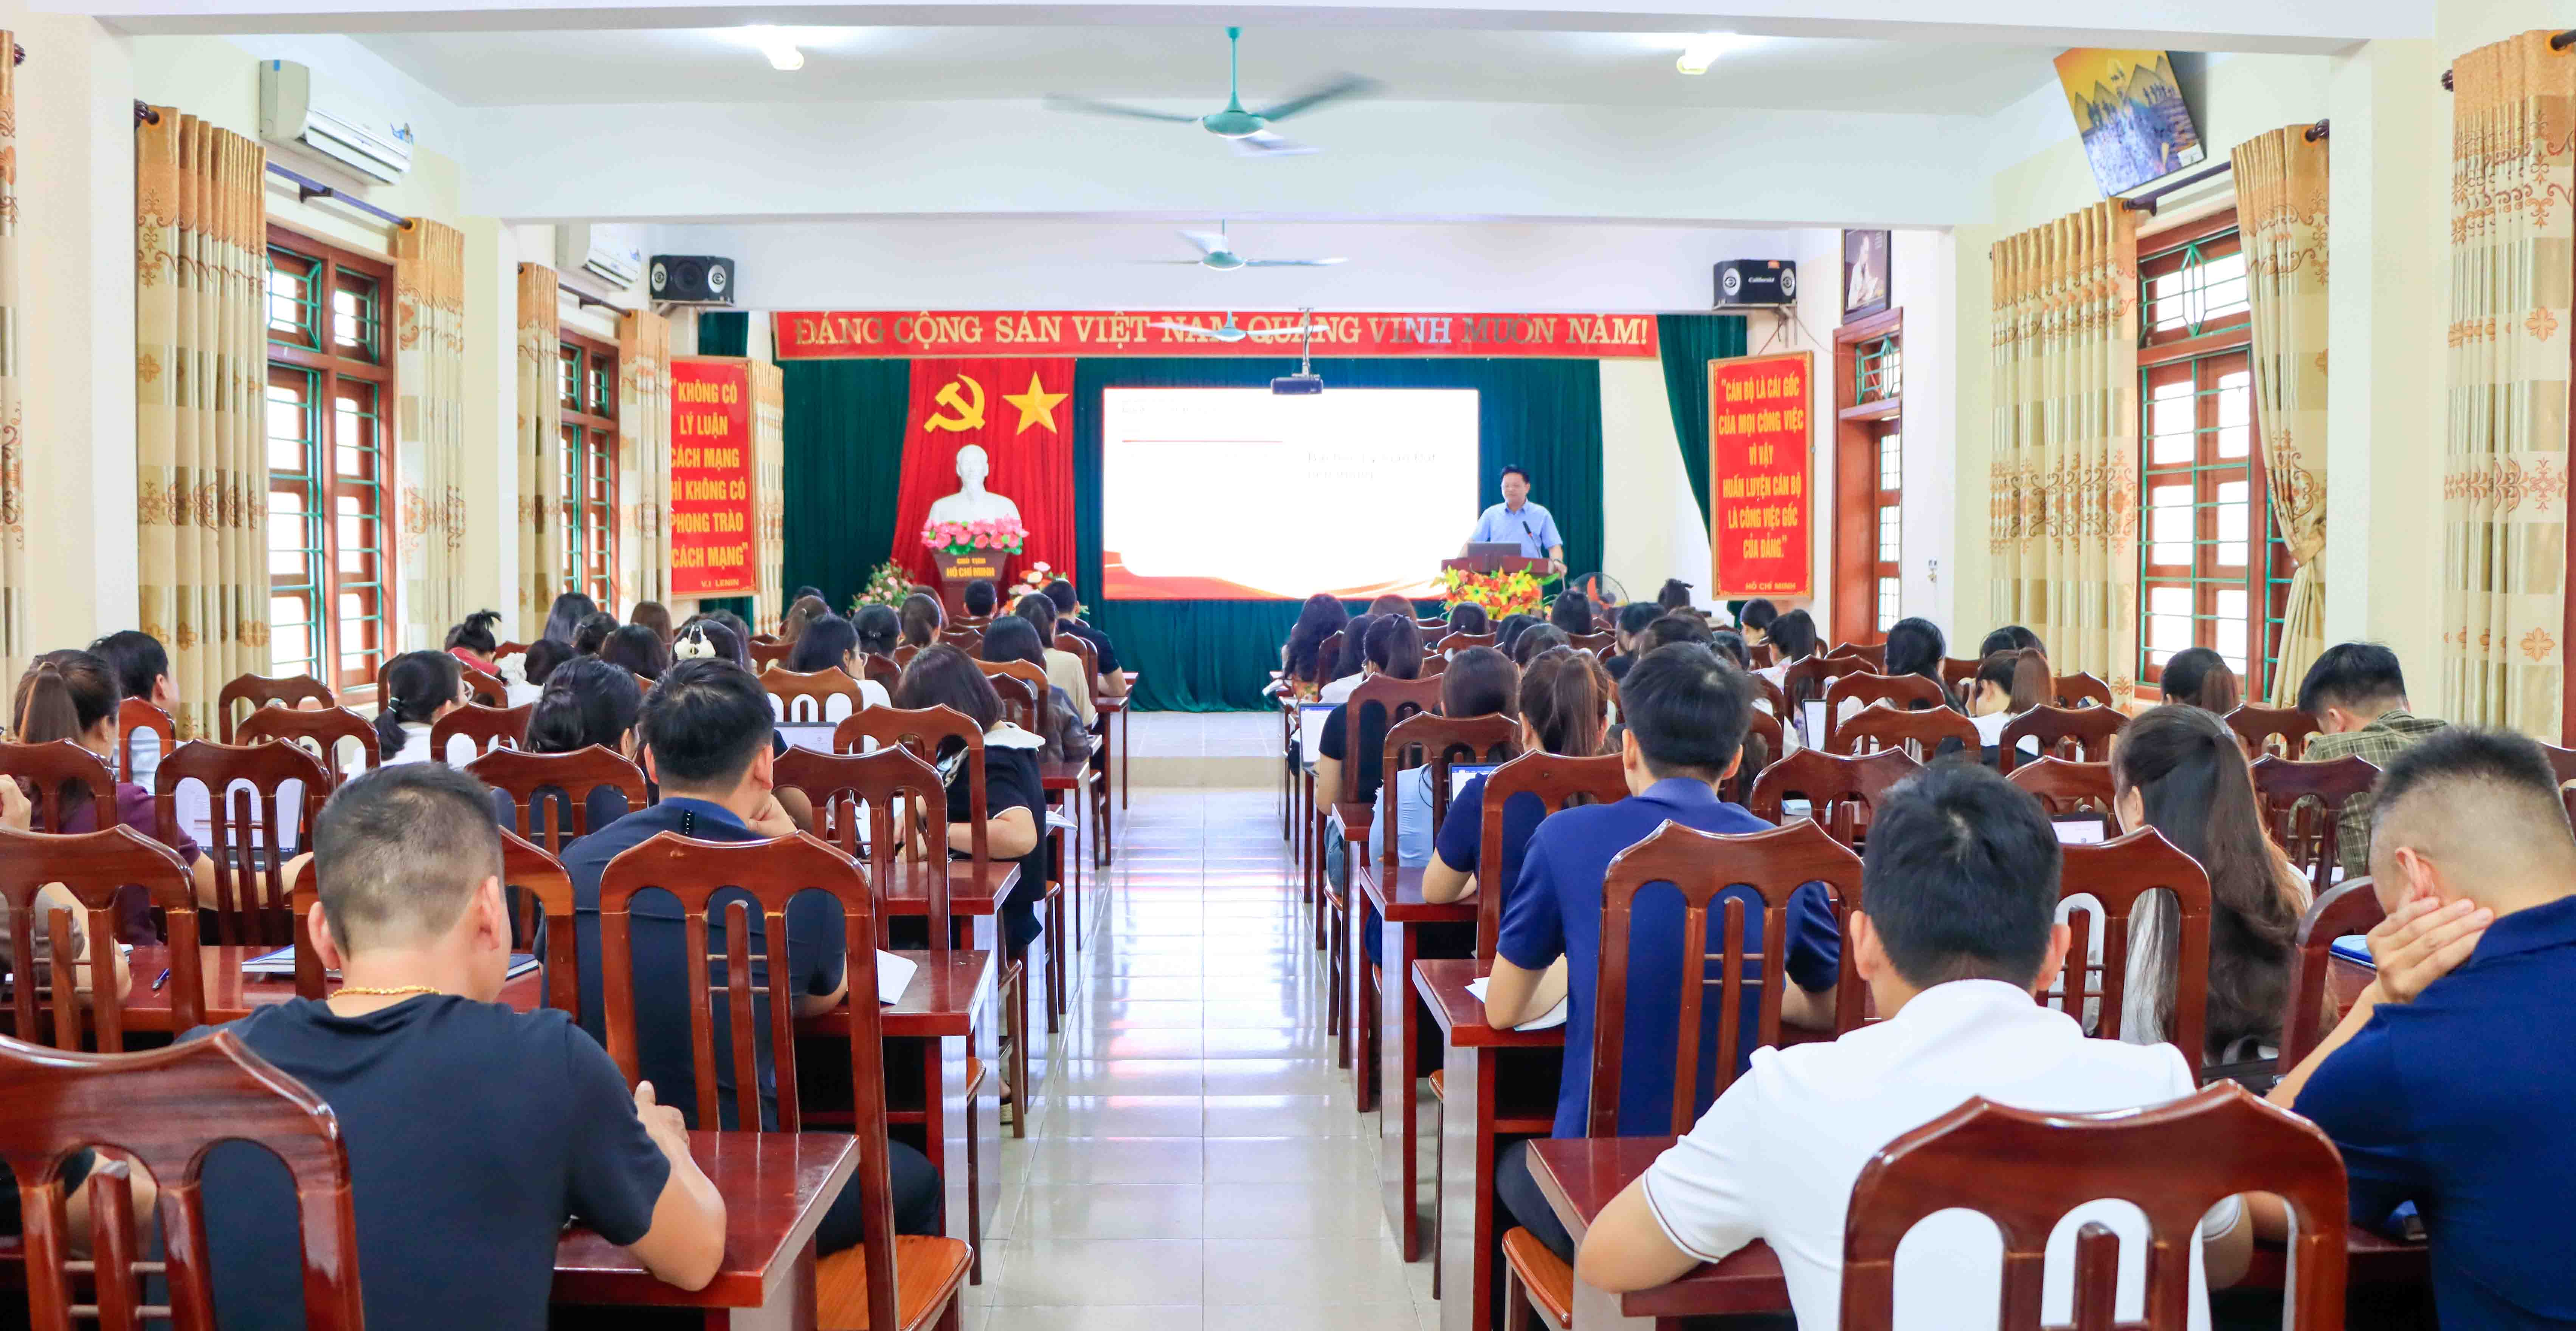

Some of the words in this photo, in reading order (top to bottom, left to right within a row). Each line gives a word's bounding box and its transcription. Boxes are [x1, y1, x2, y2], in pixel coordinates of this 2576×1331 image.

[894, 311, 983, 350] CỘNG
[1072, 311, 1150, 349] VIỆT
[1248, 316, 1362, 344] QUANG
[1367, 317, 1453, 344] VINH
[1461, 313, 1557, 344] MUÔN
[1566, 313, 1648, 345] NĂM!
[722, 380, 737, 404] CÓ
[1744, 376, 1754, 404] BỘ
[1756, 375, 1766, 399] LÀ
[1767, 374, 1780, 398] CÁI
[1783, 370, 1799, 397] GỐC
[679, 411, 693, 435] LÝ
[697, 411, 727, 439] LUẬN
[1718, 408, 1736, 435] CỦA
[1738, 414, 1755, 437] MỌI
[1758, 409, 1780, 433] CÔNG
[1784, 406, 1804, 434] VIỆC
[671, 443, 700, 468] CÁCH
[704, 448, 739, 471] MẠNG
[1749, 442, 1757, 466] VÌ
[1759, 442, 1773, 468] VẬY
[671, 476, 682, 500] HÌ
[685, 476, 726, 500] KHÔNG
[730, 476, 746, 500] CÓ
[1746, 473, 1771, 499] LUYỆN
[1773, 472, 1789, 496] CÁN
[1791, 471, 1802, 498] BỘ
[671, 513, 710, 533] PHONG
[712, 508, 744, 532] TRÀO
[1728, 506, 1739, 528] LÀ
[1740, 505, 1762, 528] CÔNG
[1763, 505, 1780, 530] VIỆC
[1782, 501, 1797, 527] GỐC
[671, 544, 704, 568] CÁCH
[1743, 532, 1758, 559] CỦA
[1745, 581, 1757, 590] HỒ
[1759, 581, 1772, 590] CHÍ
